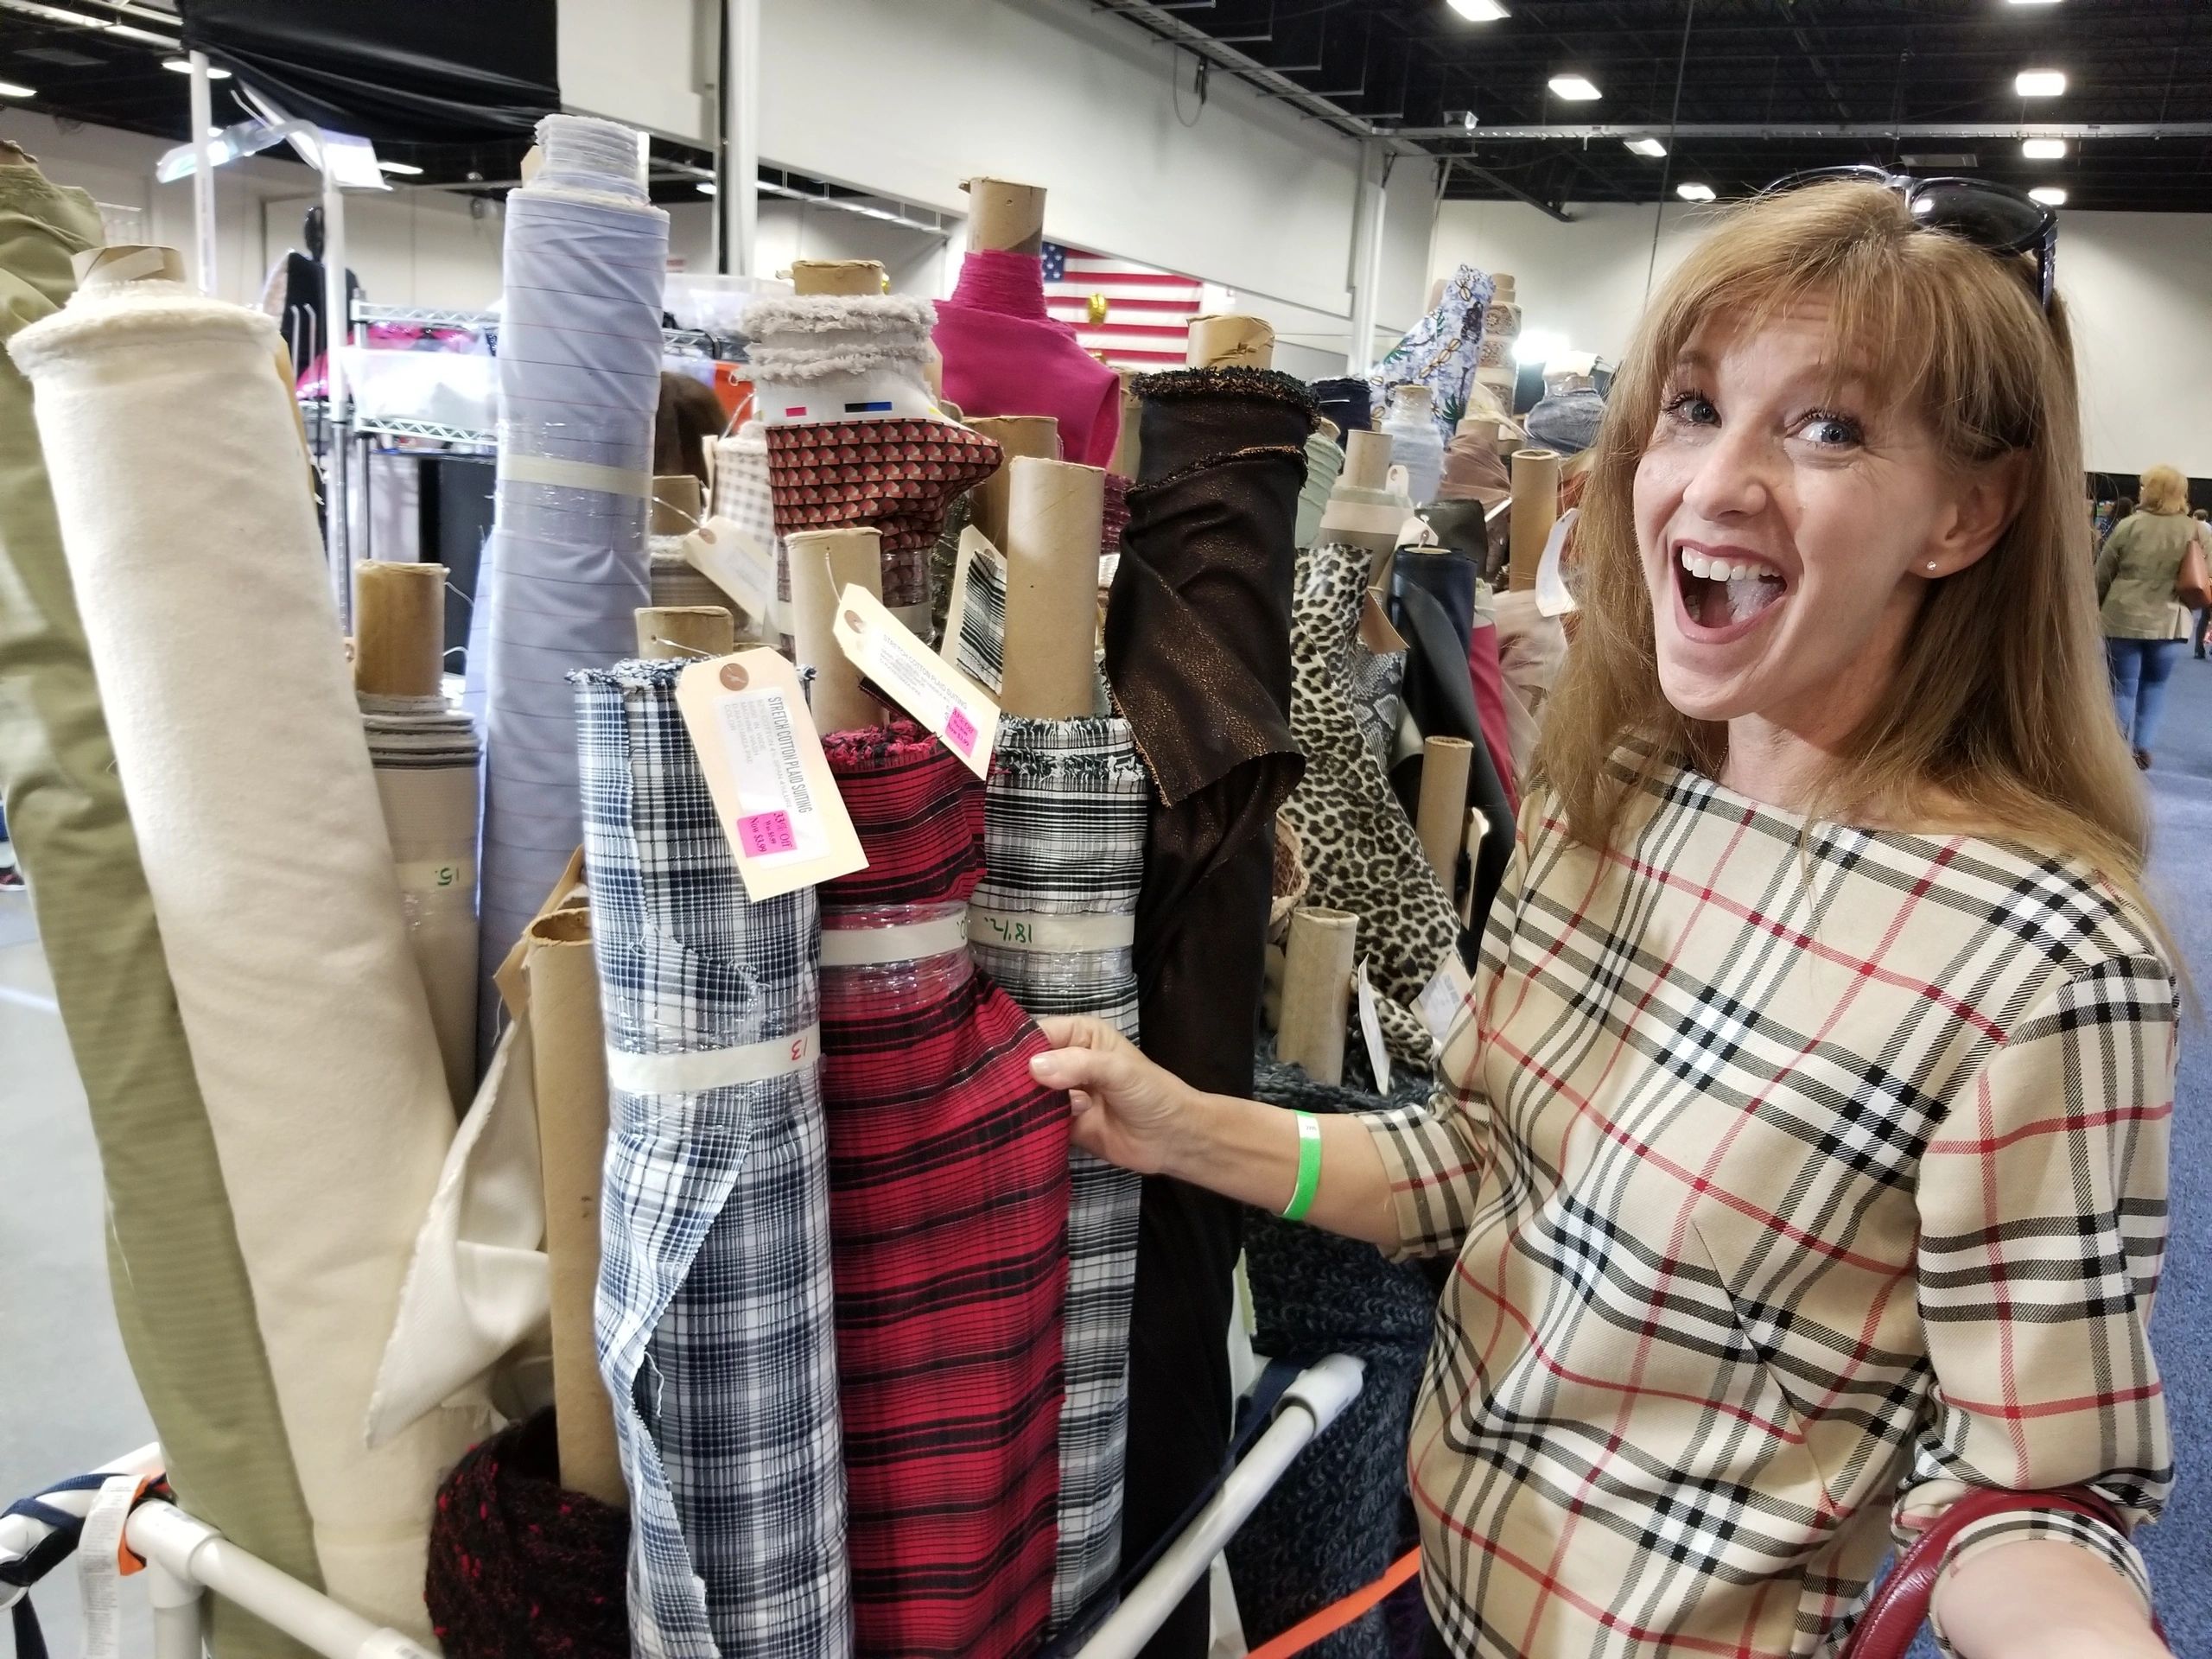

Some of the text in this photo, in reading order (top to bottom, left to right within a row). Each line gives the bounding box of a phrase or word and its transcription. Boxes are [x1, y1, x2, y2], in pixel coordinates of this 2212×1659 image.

[766, 696, 811, 815] STRETCH COTTON PLAID SUITING
[747, 817, 767, 853] Now $3.99
[778, 831, 793, 849] Off
